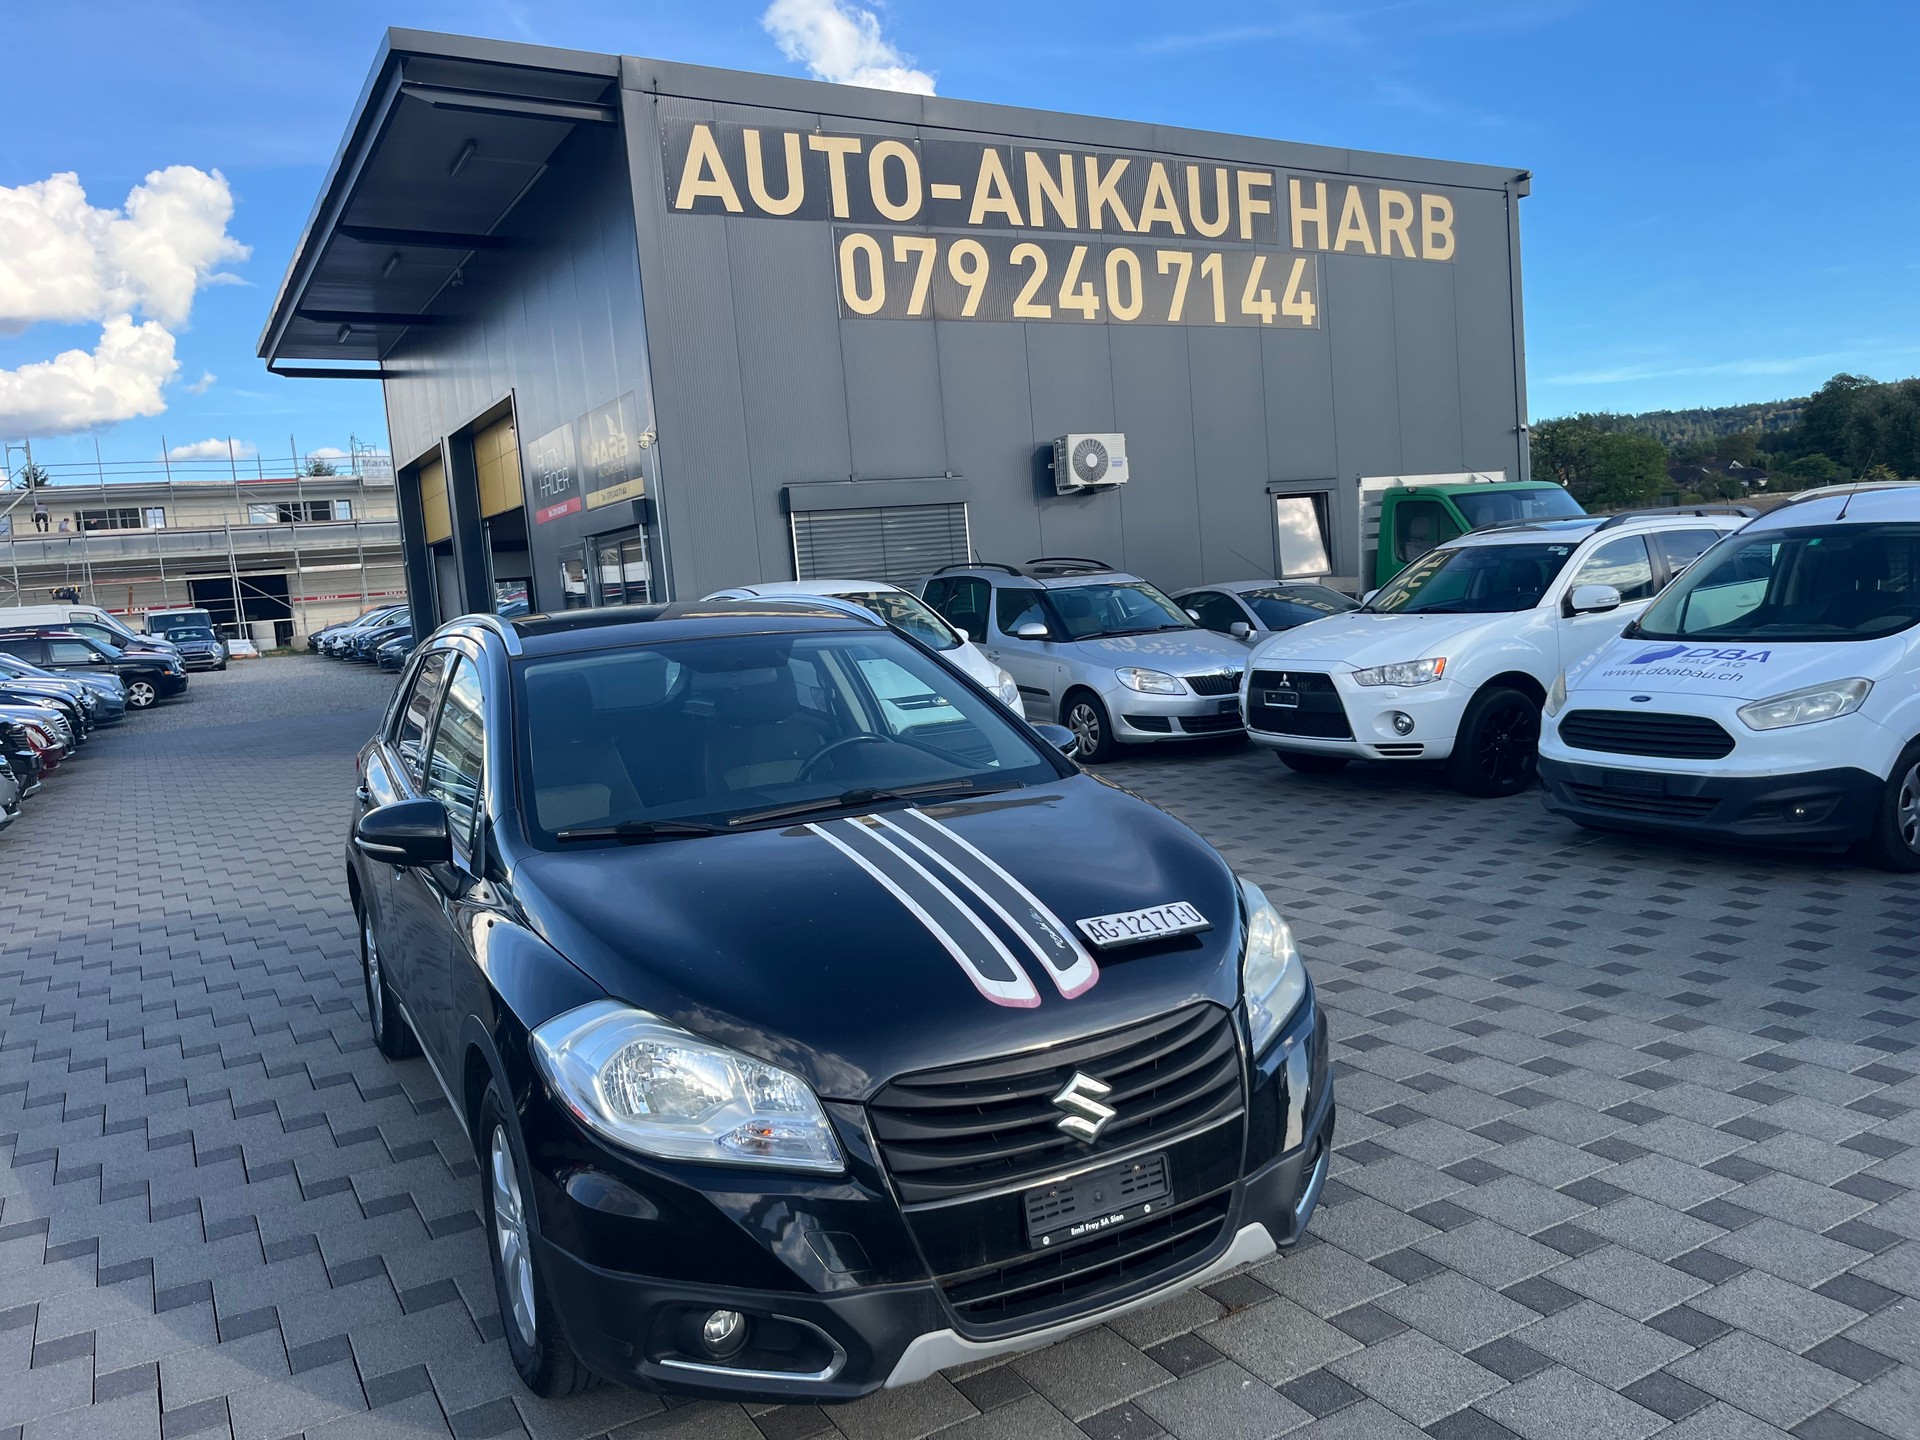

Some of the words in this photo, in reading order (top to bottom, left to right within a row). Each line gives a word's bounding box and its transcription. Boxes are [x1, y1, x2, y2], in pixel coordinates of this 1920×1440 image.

[675, 124, 1271, 239] AUTO-ANKAUF
[1289, 179, 1455, 261] HARB
[839, 233, 989, 316] 079
[1009, 243, 1143, 321] 240
[591, 431, 629, 467] HARB
[1682, 648, 1772, 663] DBA
[1602, 666, 1744, 682] www.dbabau.ch
[1070, 1224, 1085, 1235] Emil
[1085, 1222, 1100, 1231] Frey
[1100, 1217, 1110, 1227] SA
[1110, 1214, 1124, 1223] Sion
